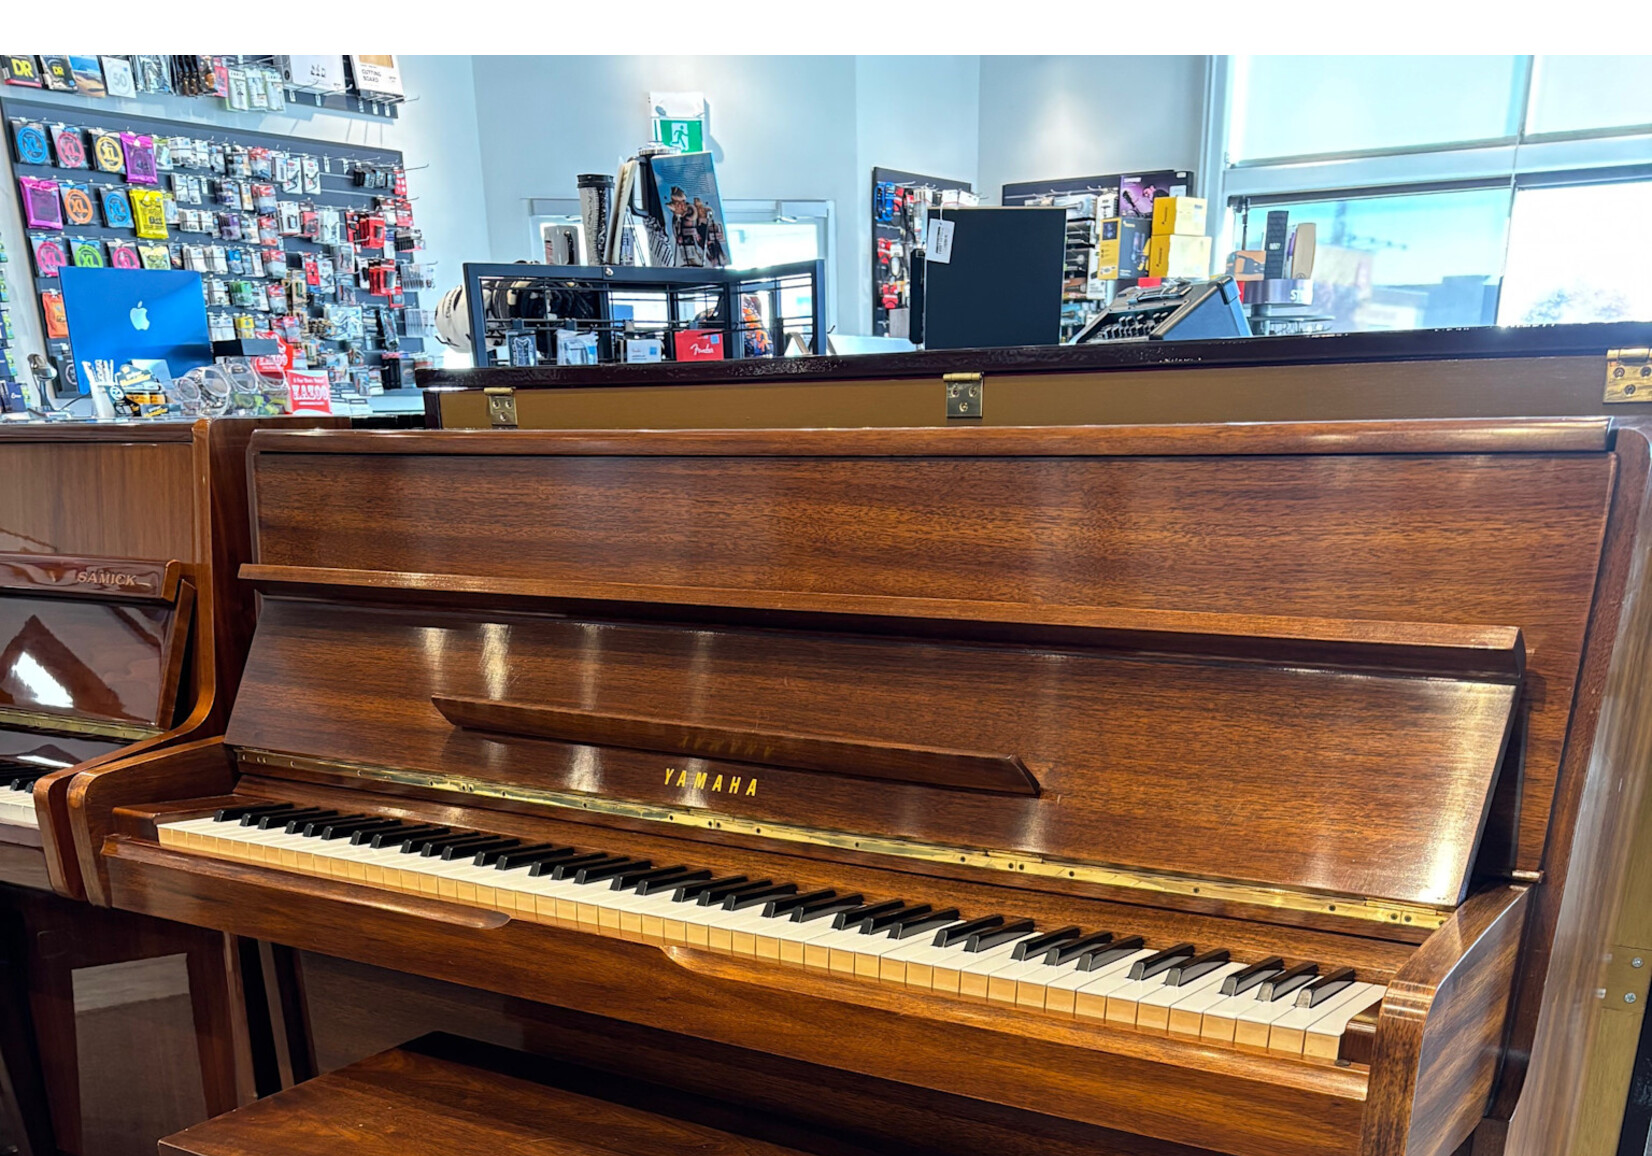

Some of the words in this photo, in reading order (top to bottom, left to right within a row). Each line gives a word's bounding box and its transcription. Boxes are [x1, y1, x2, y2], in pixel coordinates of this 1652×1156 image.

[12, 59, 34, 78] DR
[52, 66, 65, 77] DR
[70, 198, 89, 213] XL
[77, 570, 137, 587] SAMICK
[664, 768, 758, 797] YAMAHA
